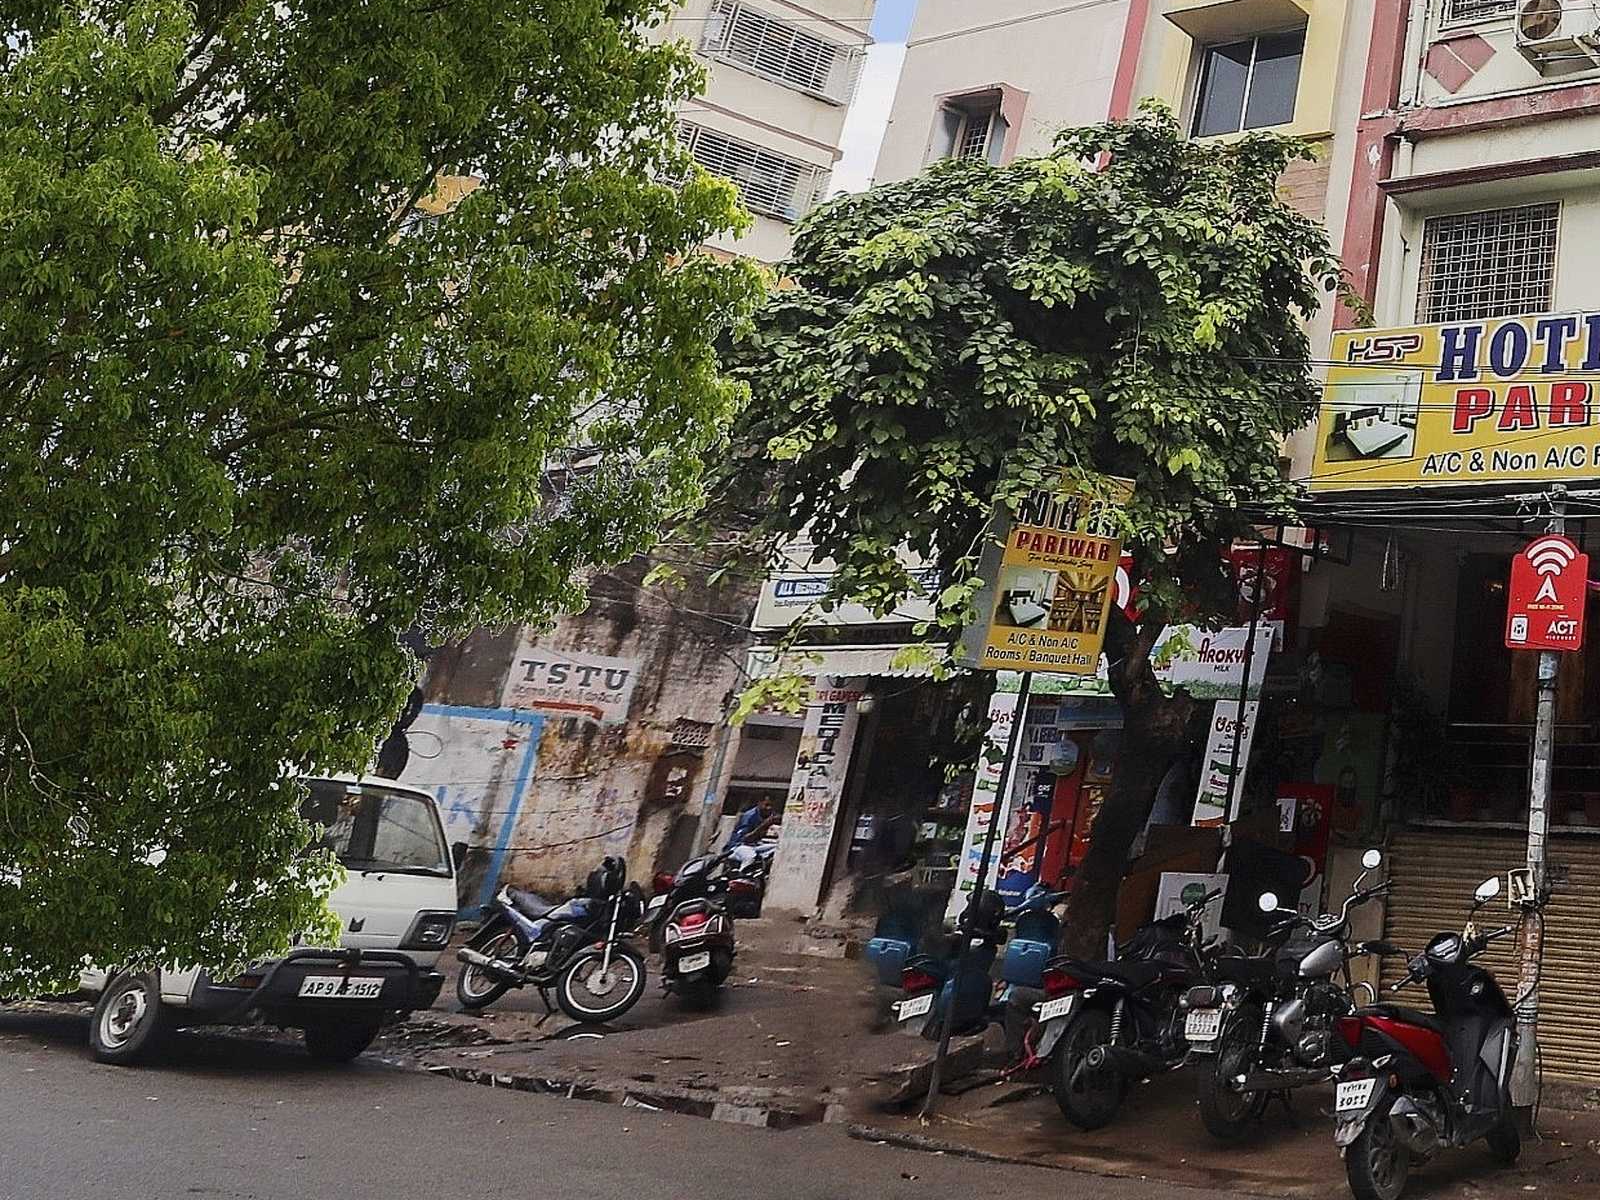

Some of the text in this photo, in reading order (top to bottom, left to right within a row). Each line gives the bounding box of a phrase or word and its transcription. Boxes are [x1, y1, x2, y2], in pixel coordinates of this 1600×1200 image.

[1423, 451, 1462, 475] A/C
[1469, 451, 1485, 472] &
[1492, 450, 1536, 472] Non
[1544, 446, 1586, 469] A/C
[1015, 530, 1110, 563] PARIWAR
[1547, 620, 1578, 635] ACT
[1038, 635, 1059, 648] Non
[985, 646, 1022, 661] Rooms
[1029, 650, 1073, 665] Banquet
[1073, 652, 1093, 666] Hall
[520, 660, 630, 691] TSTU
[1213, 664, 1230, 673] MILK
[806, 702, 848, 790] MEDICAL
[304, 982, 325, 995] AP
[325, 982, 334, 995] 9
[354, 983, 381, 996] 1512
